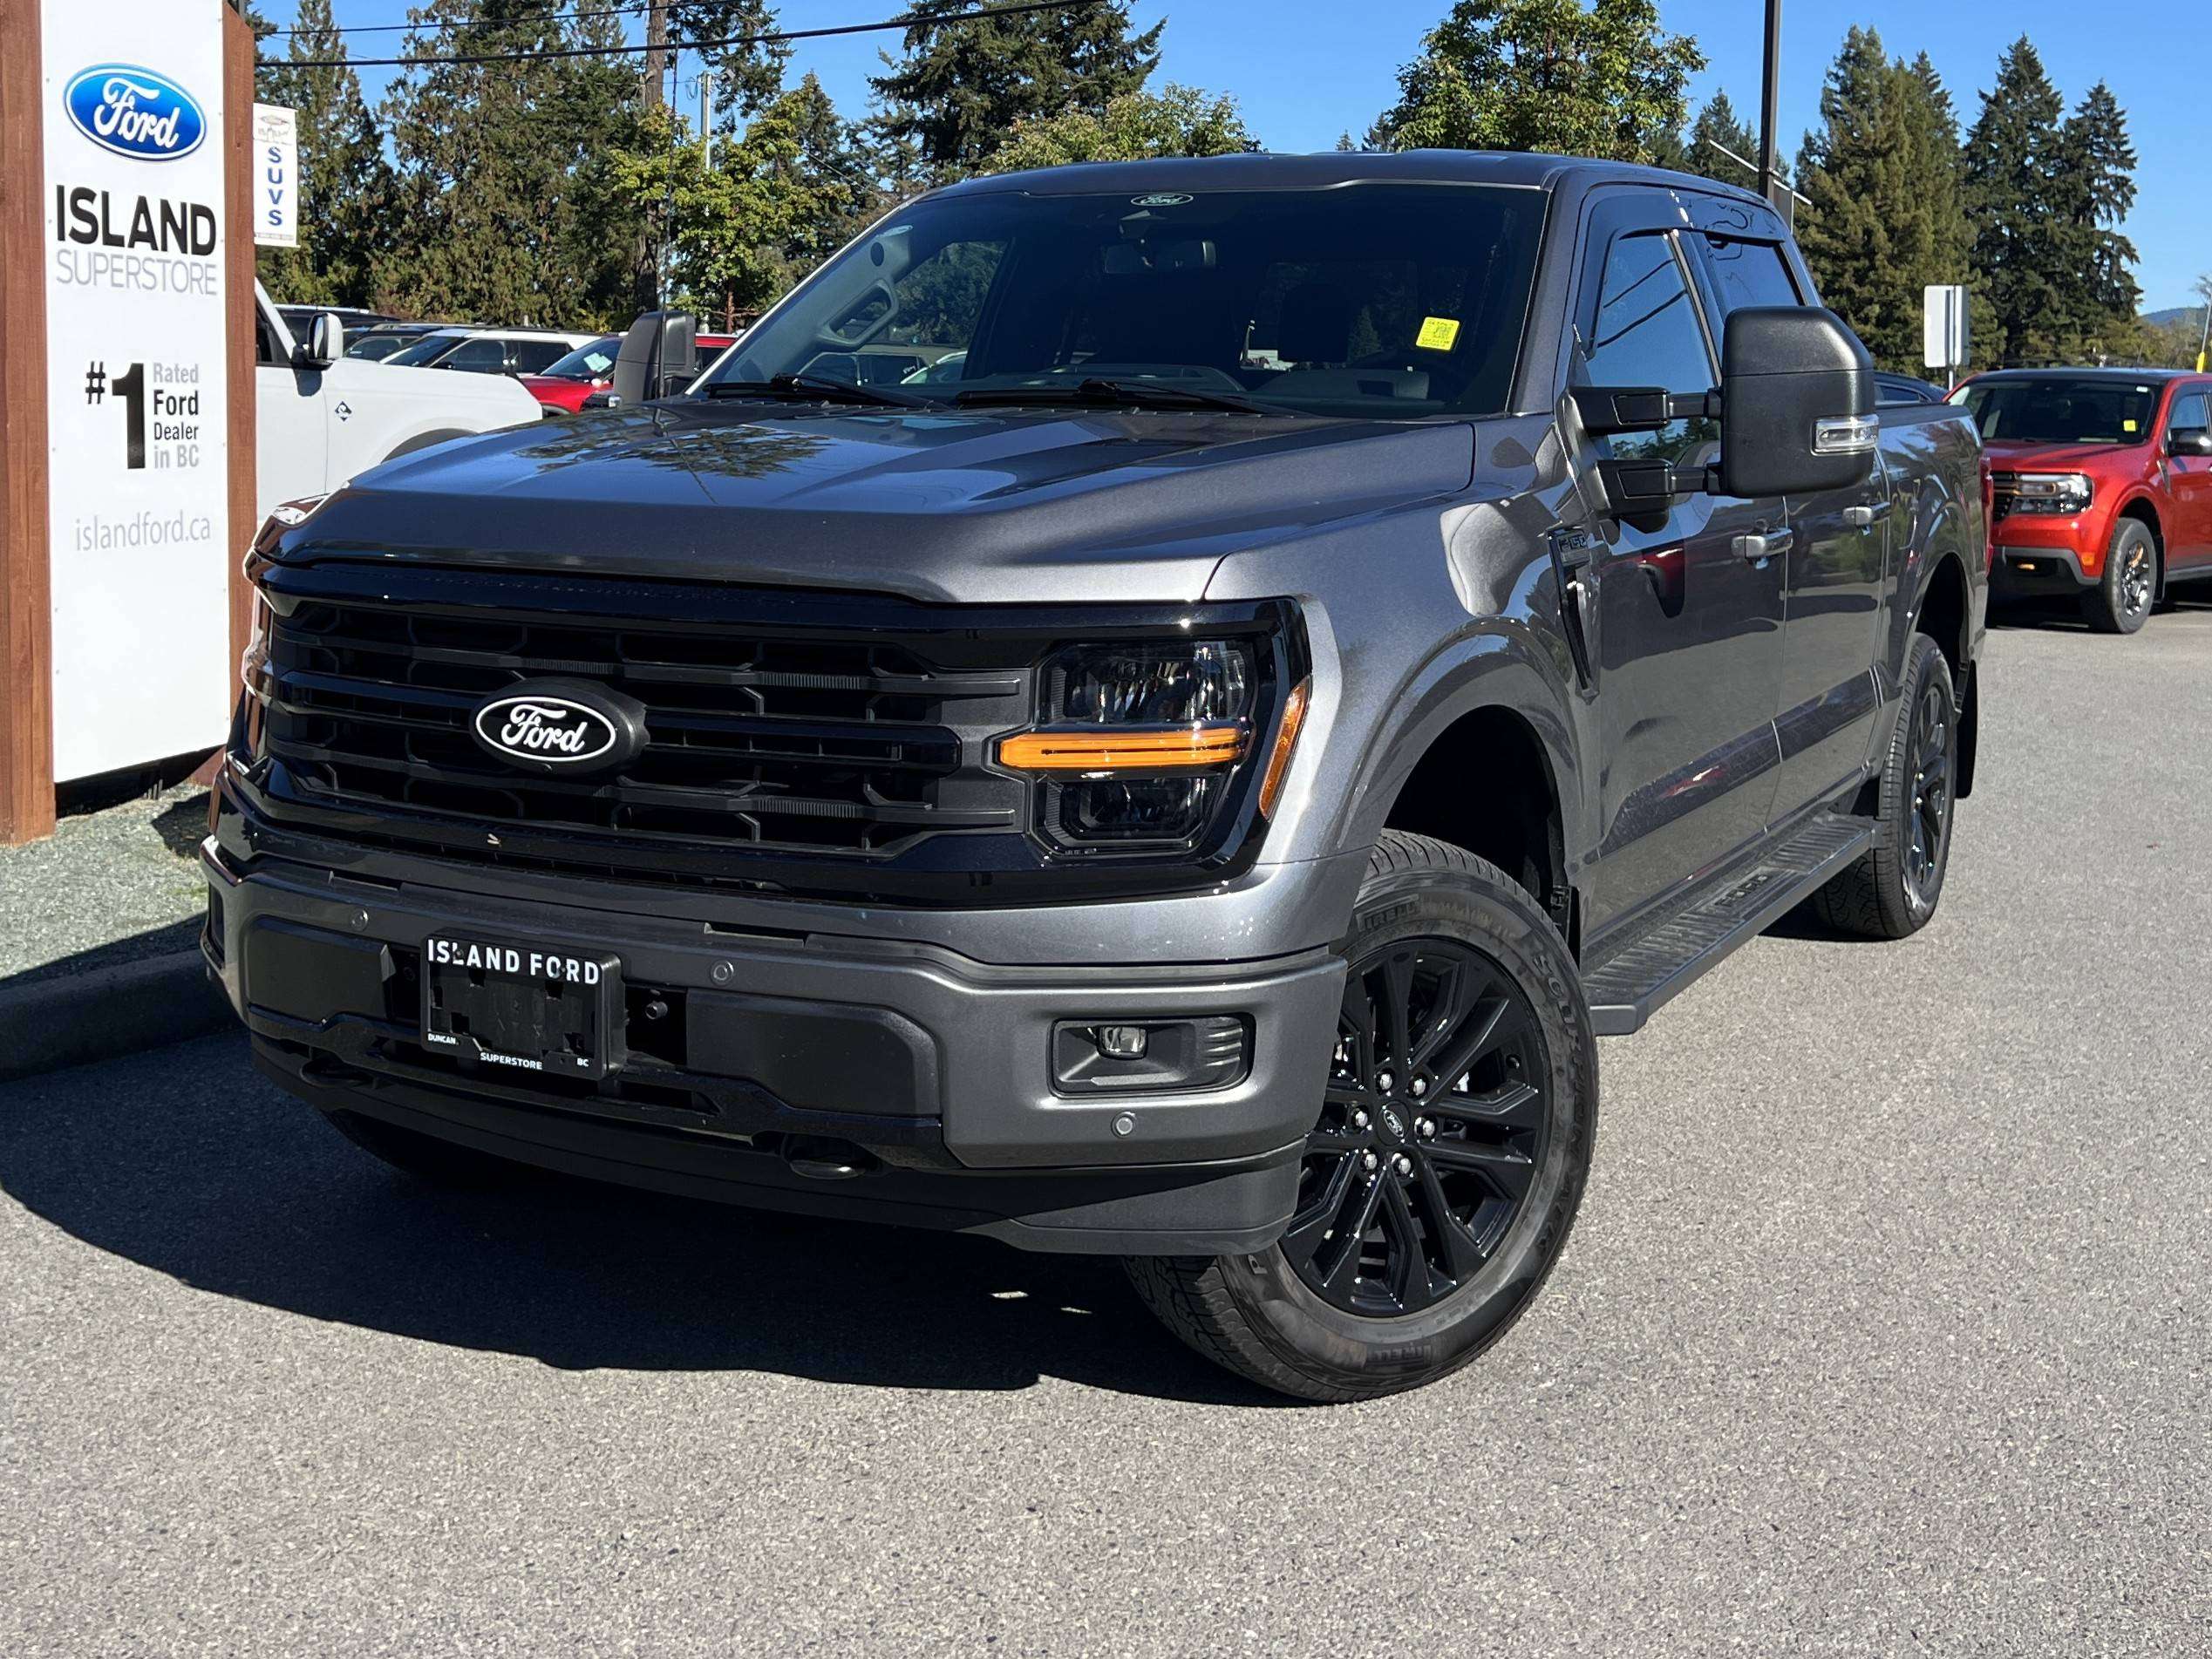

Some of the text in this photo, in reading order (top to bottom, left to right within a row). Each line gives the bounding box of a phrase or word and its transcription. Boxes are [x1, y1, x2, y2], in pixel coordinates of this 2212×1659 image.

[93, 77, 181, 149] Ford
[267, 146, 284, 228] SUVS
[56, 184, 217, 257] ISLAND
[56, 248, 218, 296] SUPERSTORE
[153, 362, 200, 384] Rated
[85, 361, 146, 469] #1
[153, 389, 200, 416] Ford
[153, 421, 200, 441] Dealer
[153, 444, 200, 469] in BC
[75, 509, 211, 551] islandford.ca
[500, 704, 589, 753] Ford
[427, 938, 600, 985] ISLAND FORD
[480, 1052, 543, 1071] SUPERSTORE
[576, 1057, 589, 1068] BC
